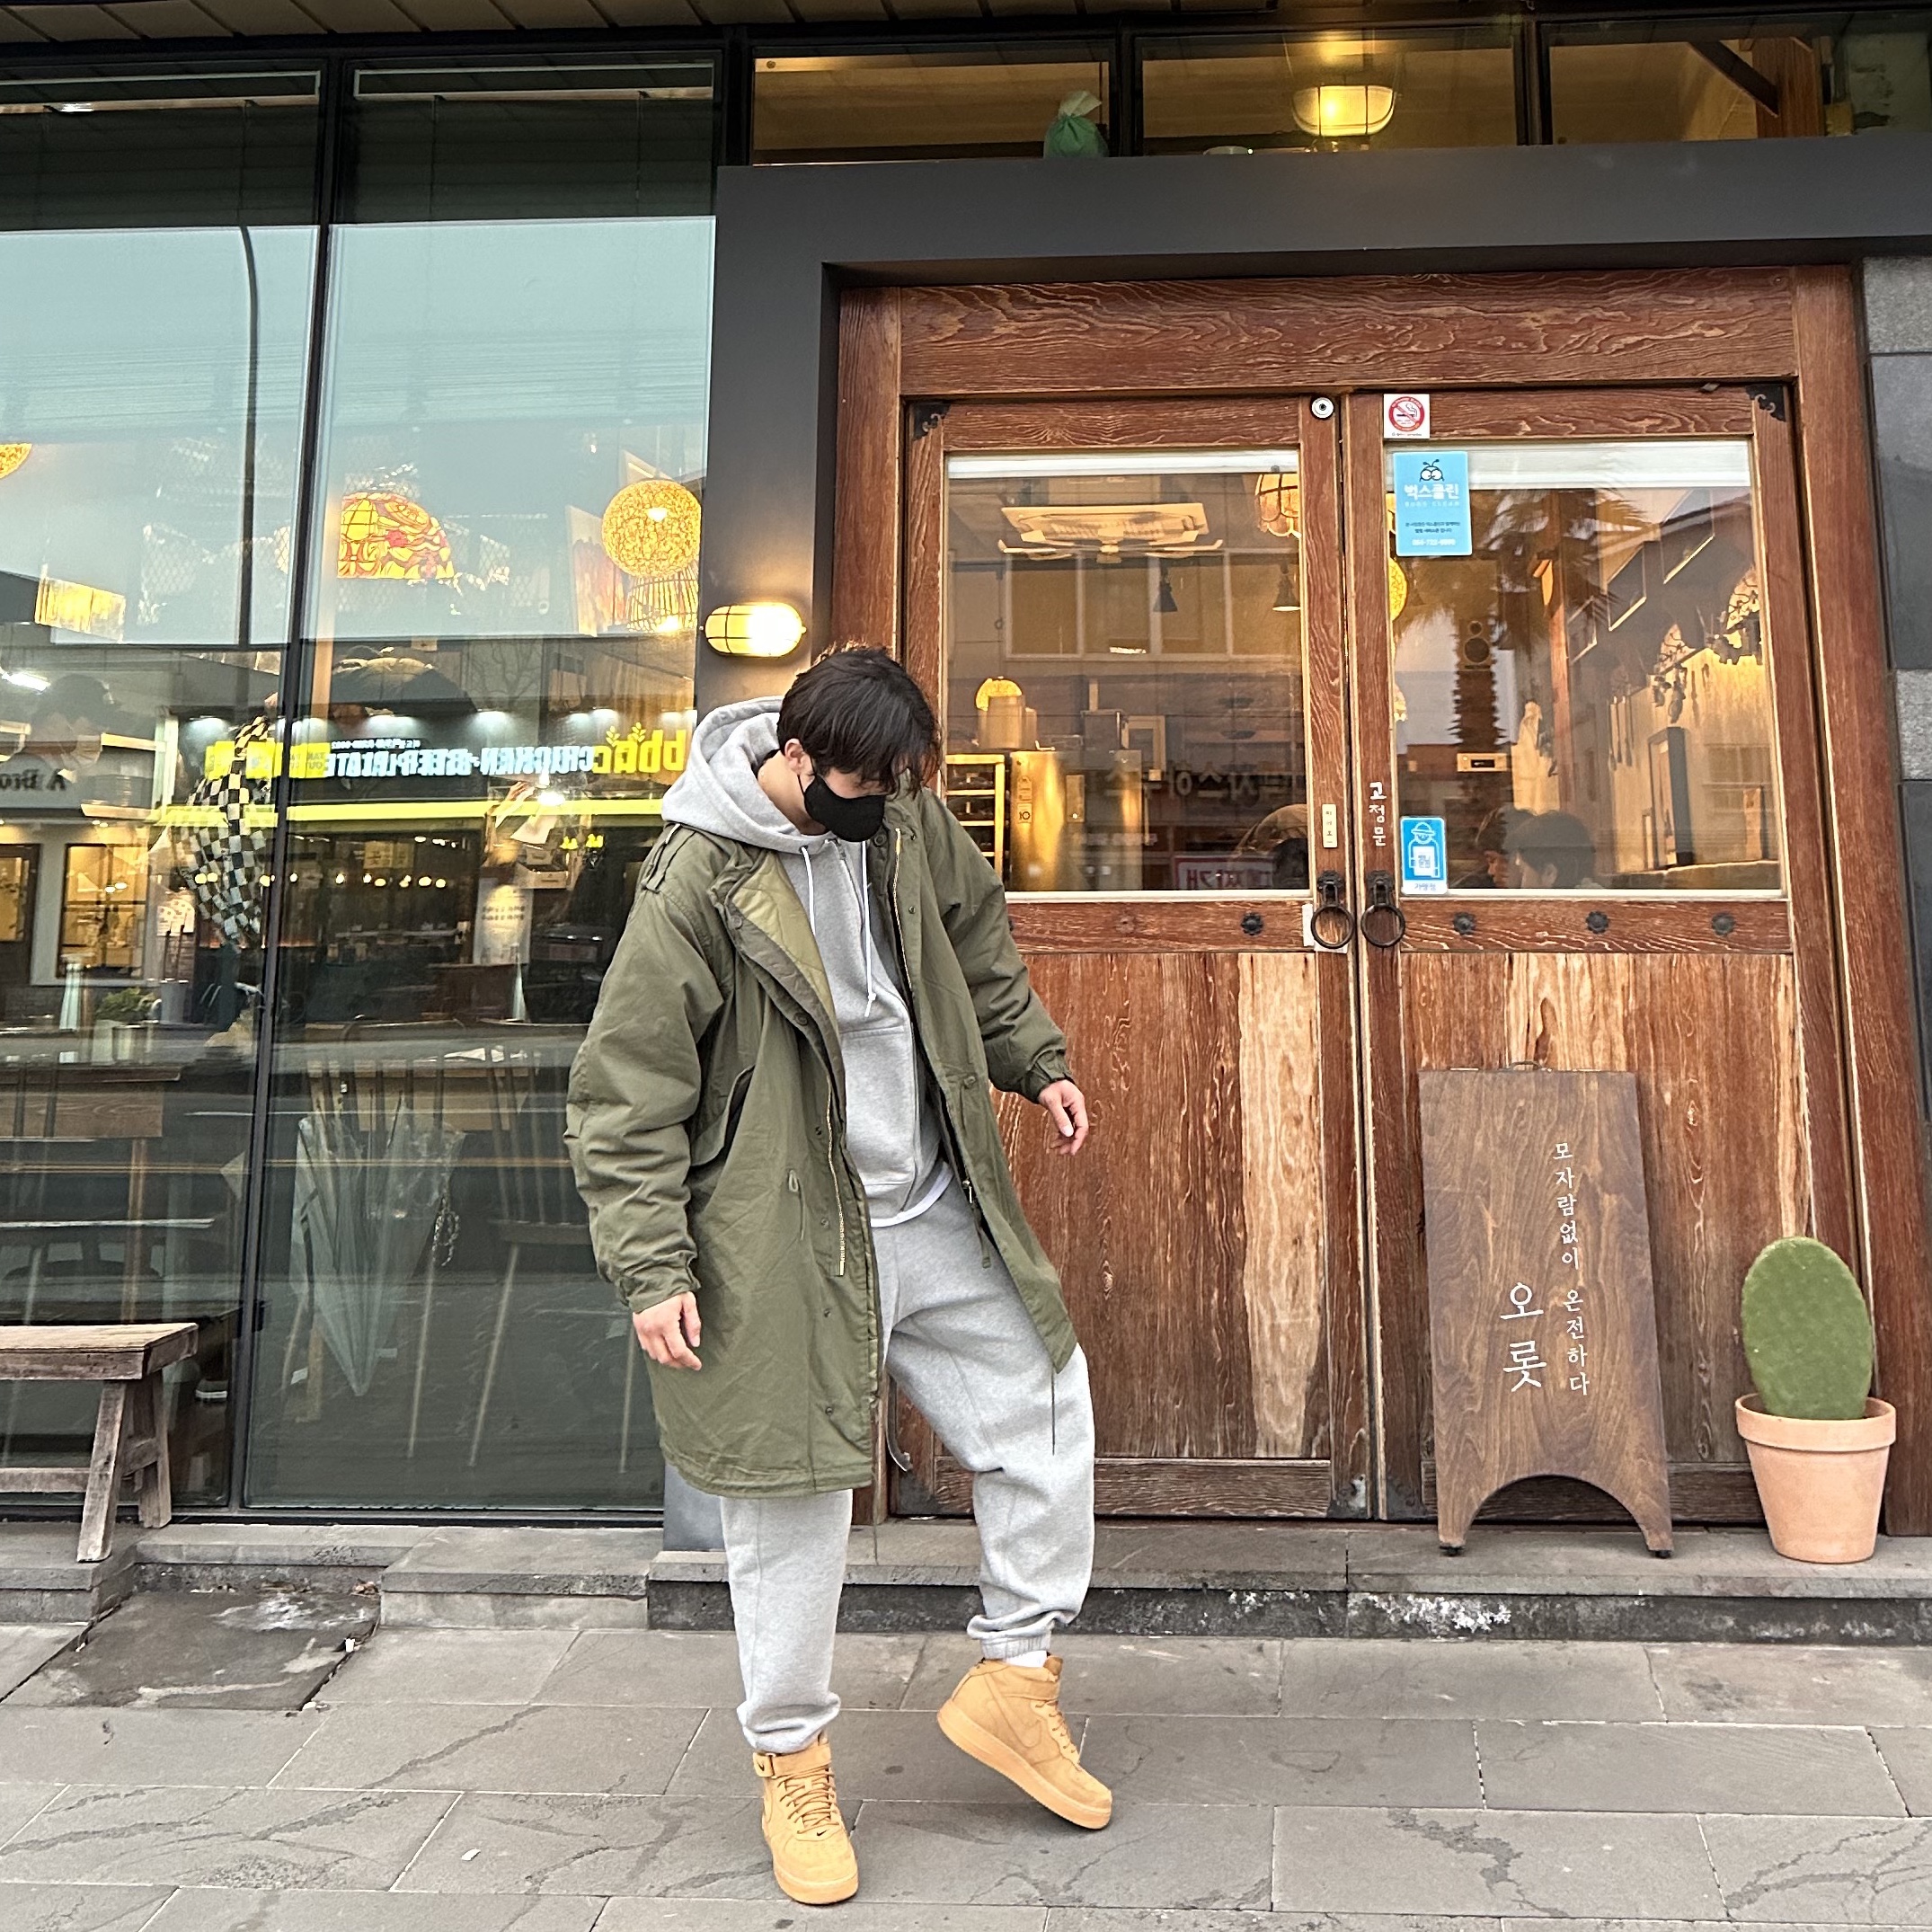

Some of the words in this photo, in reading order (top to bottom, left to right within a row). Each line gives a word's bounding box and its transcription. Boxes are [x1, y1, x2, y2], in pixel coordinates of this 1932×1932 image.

[1404, 483, 1460, 501] 벅스클린
[1368, 781, 1387, 847] 고정문
[1553, 1141, 1581, 1271] 모자람없이
[1500, 1281, 1547, 1393] 오롯
[1563, 1289, 1591, 1396] 온전하다
